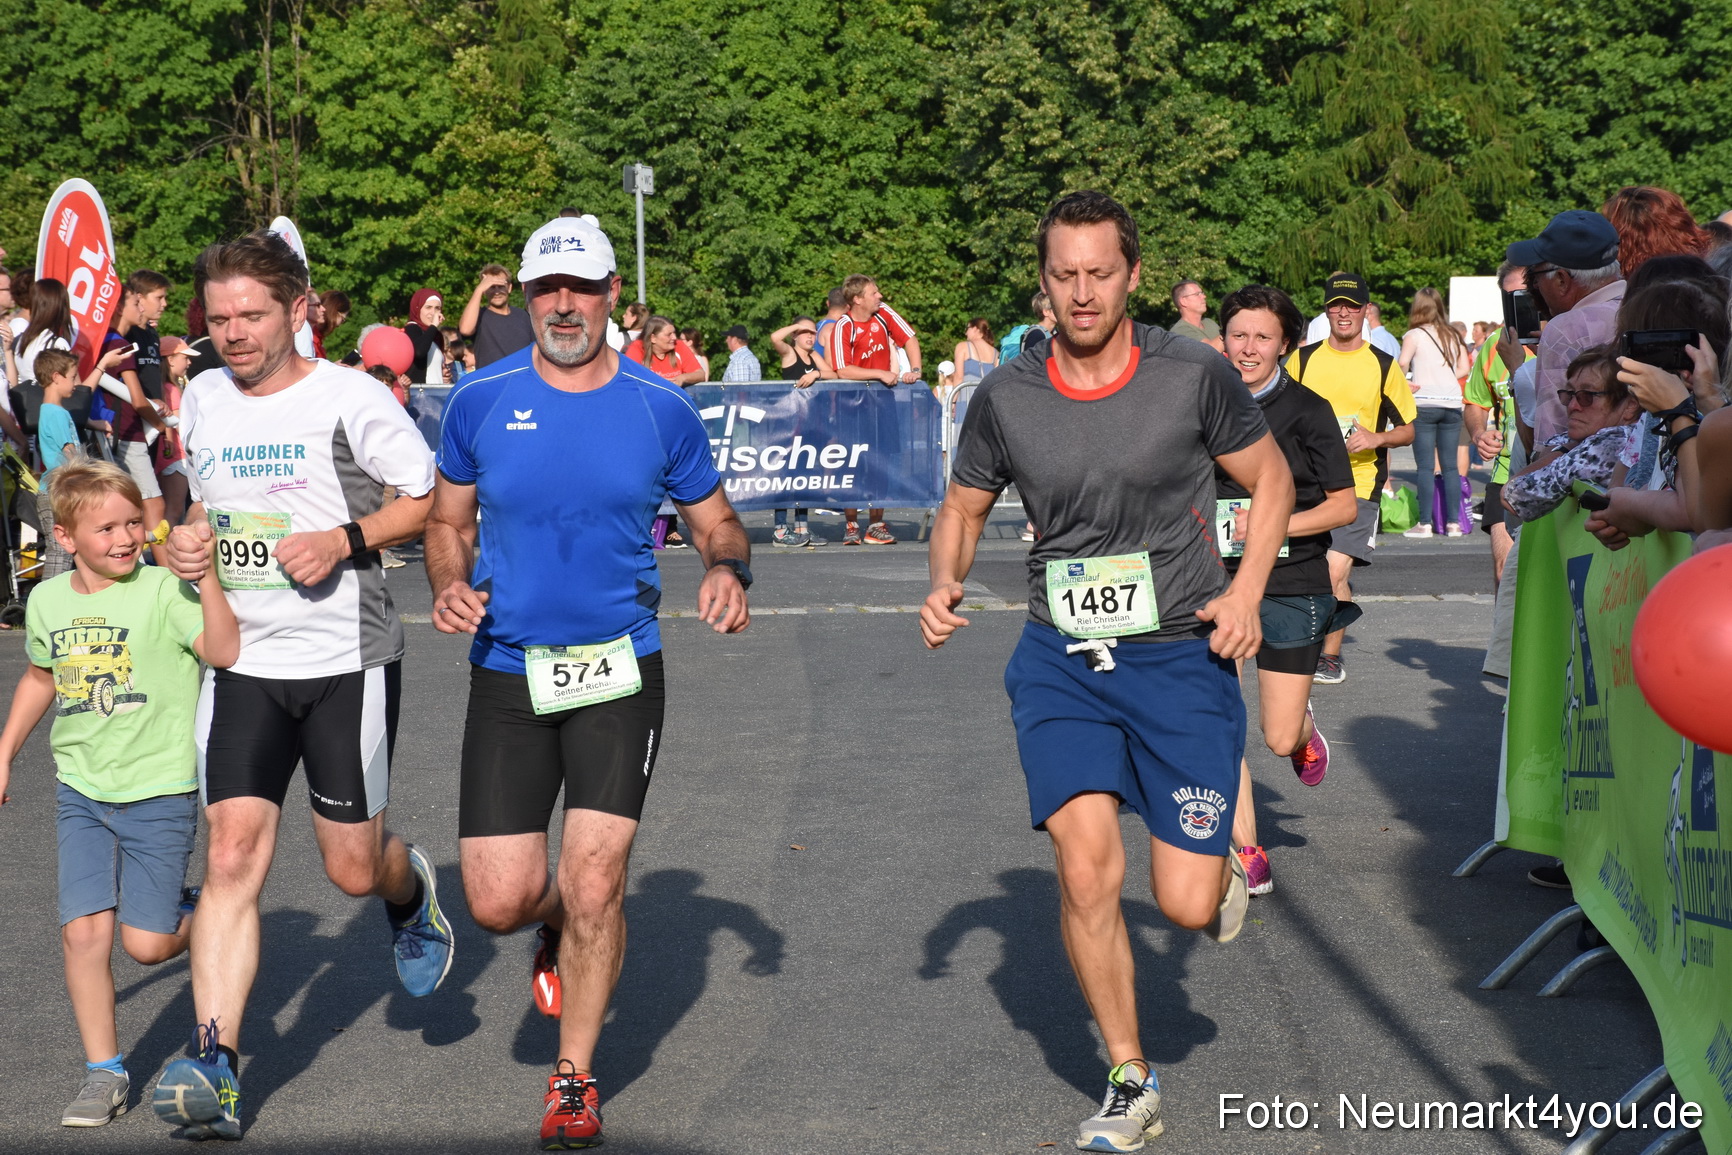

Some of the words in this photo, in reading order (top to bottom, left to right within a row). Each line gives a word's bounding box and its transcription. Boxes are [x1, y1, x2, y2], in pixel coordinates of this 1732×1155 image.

[539, 243, 562, 256] MOVE
[506, 421, 537, 430] erima
[222, 444, 306, 462] HAUBNER
[231, 463, 294, 478] TREPPEN
[724, 474, 855, 493] UTOMOBILE
[219, 539, 269, 568] 999
[1061, 573, 1100, 584] firmenlauf
[1125, 574, 1145, 583] 2019
[1062, 583, 1137, 617] 1487
[73, 617, 105, 626] AFRICAN
[1076, 617, 1092, 625] Riel
[1093, 614, 1130, 624] Christian
[542, 650, 584, 659] firmenlauf
[607, 644, 626, 656] 2019
[552, 657, 613, 688] 574
[554, 686, 585, 698] Geitner
[1171, 786, 1228, 814] HOLLISTER
